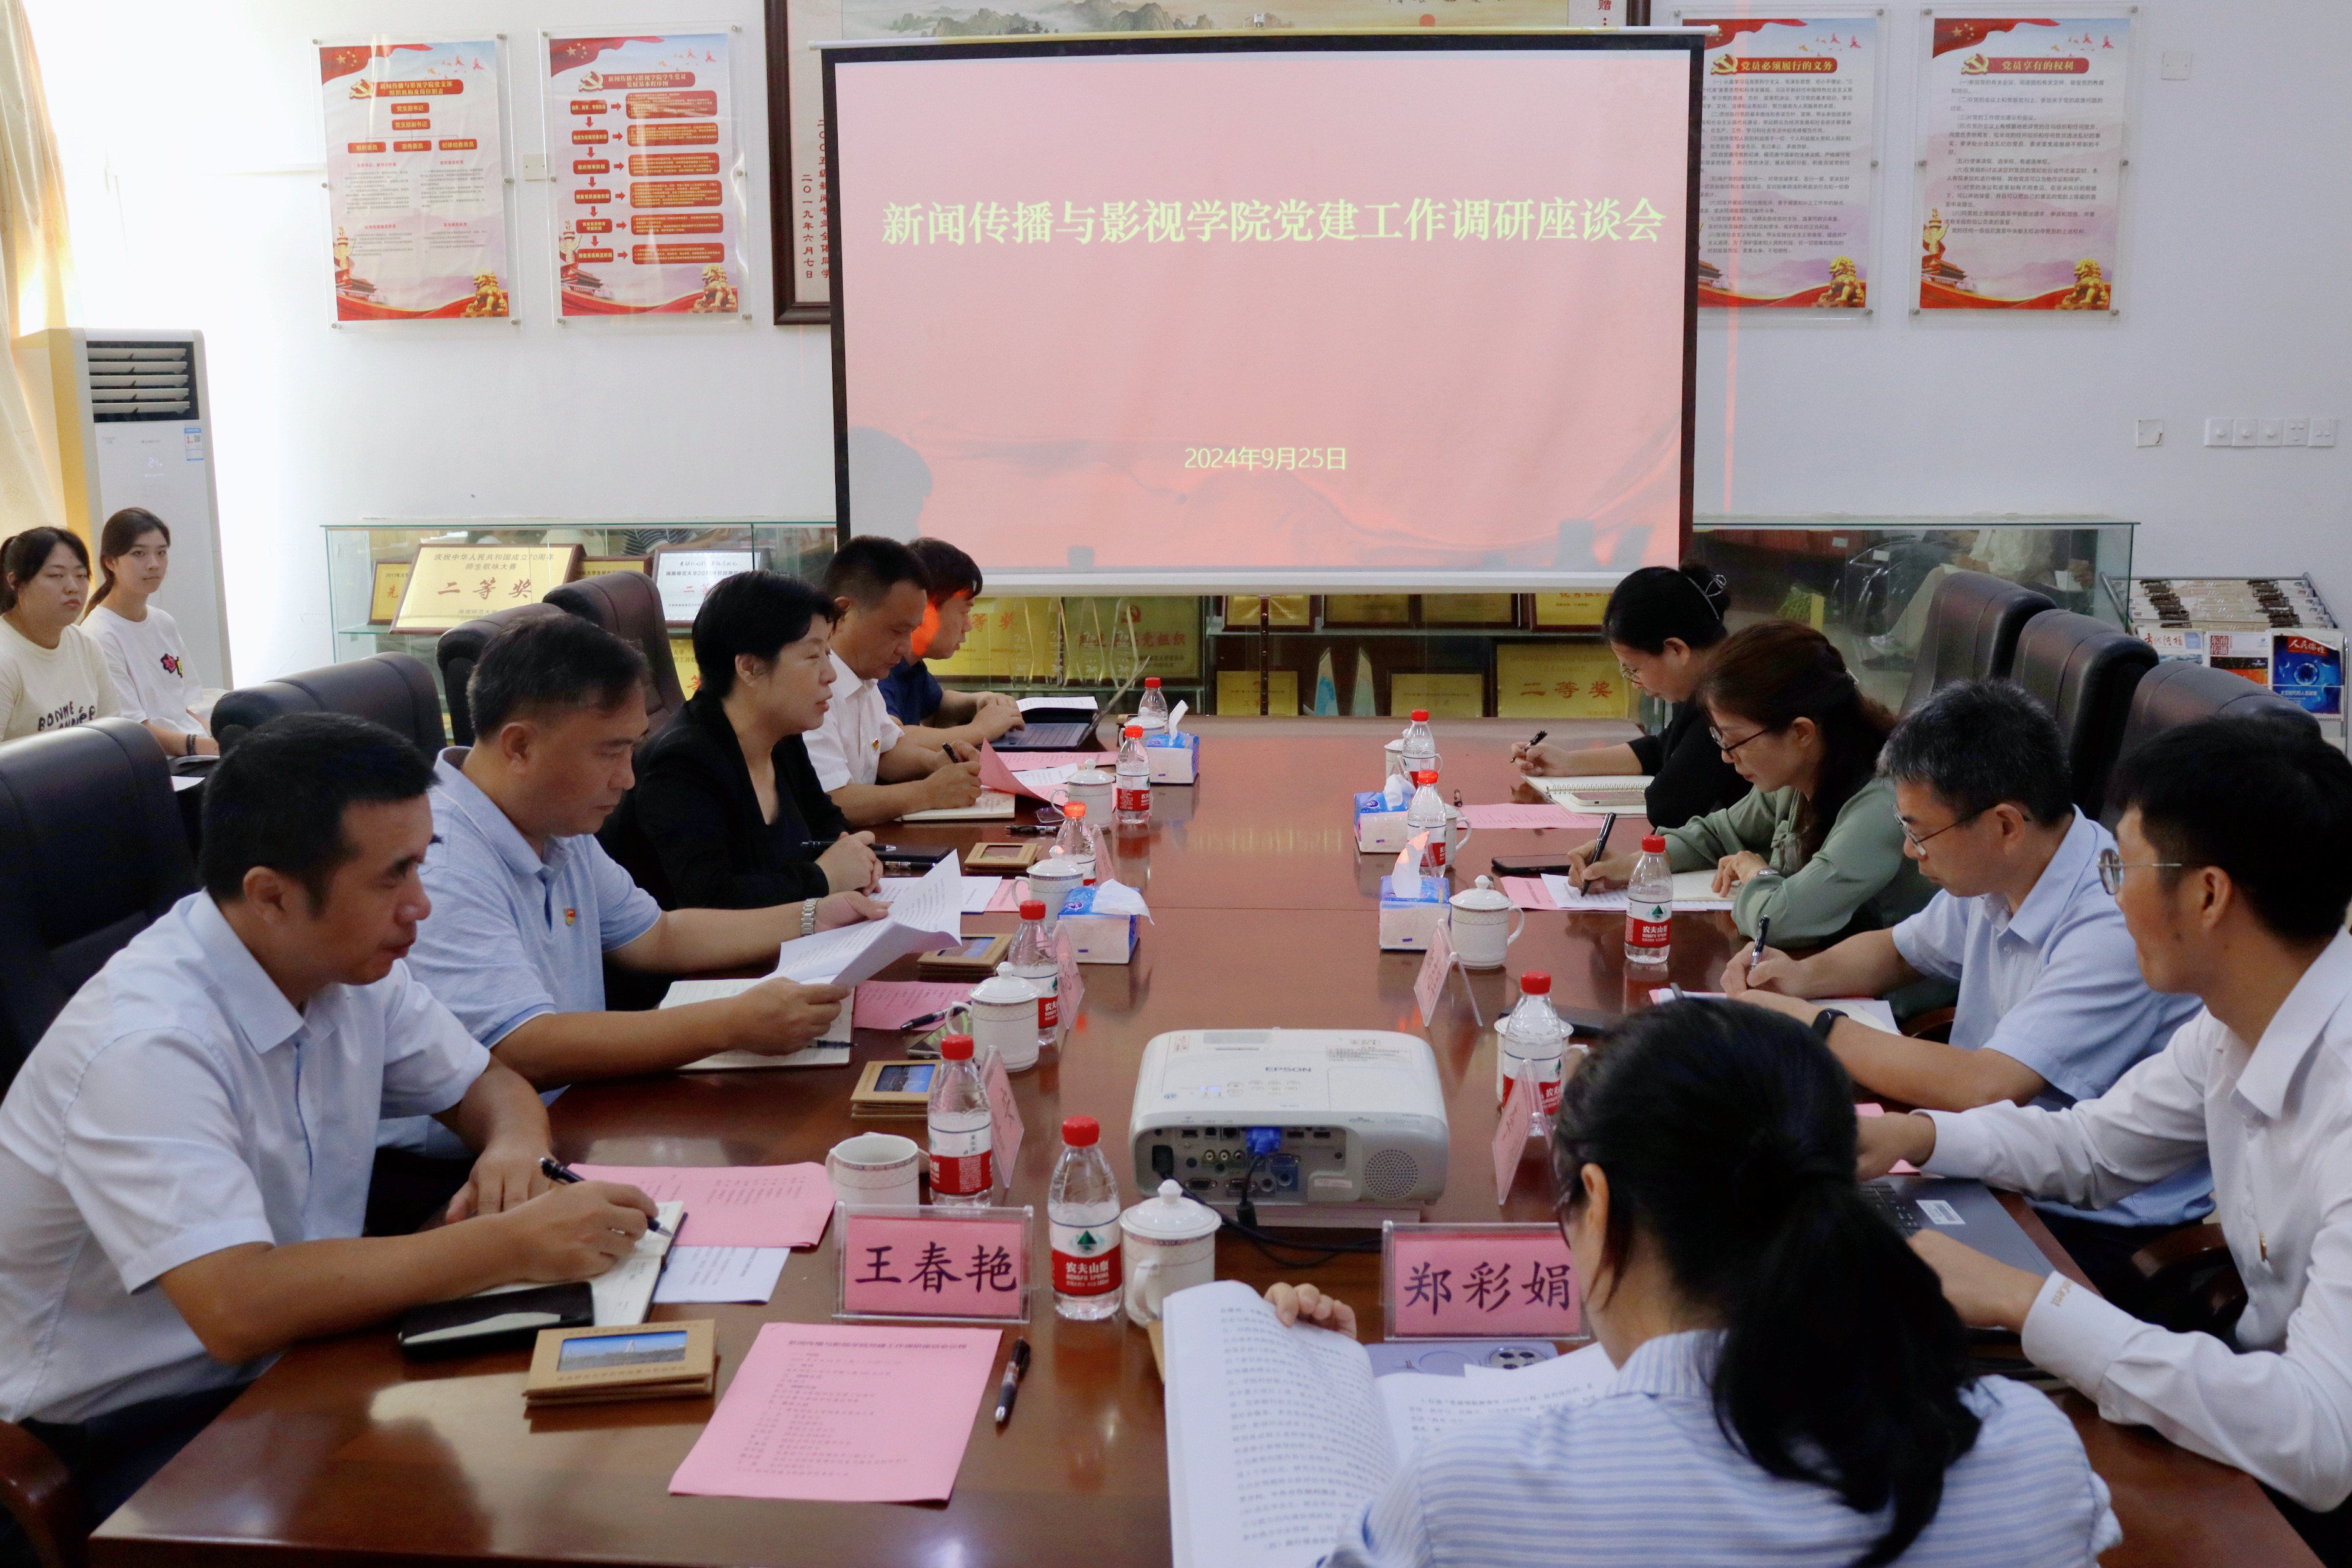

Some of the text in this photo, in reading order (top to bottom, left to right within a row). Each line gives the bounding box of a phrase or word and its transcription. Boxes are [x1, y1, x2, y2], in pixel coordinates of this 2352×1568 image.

[1741, 61, 1832, 71] 党员必须履行的义务
[2002, 61, 2074, 71] 党员享有的权利
[380, 81, 453, 89] 新闻传播与影视学院党支部
[608, 74, 686, 83] 新闻传播与影视学院学生党员
[389, 88, 443, 96] 组织机构及岗位职责
[882, 197, 1666, 246] 新闻传播与影视学院党建工作调研座谈会
[1184, 446, 1347, 472] 2024年9月25日
[438, 577, 533, 600] 二等奖
[1520, 680, 1614, 699] 二等奖
[1642, 925, 1667, 933] 农夫山泉
[856, 1241, 1017, 1294] 王春艳
[1066, 1259, 1109, 1274] 农夫山泉
[1404, 1261, 1571, 1316] 郑彩娟
